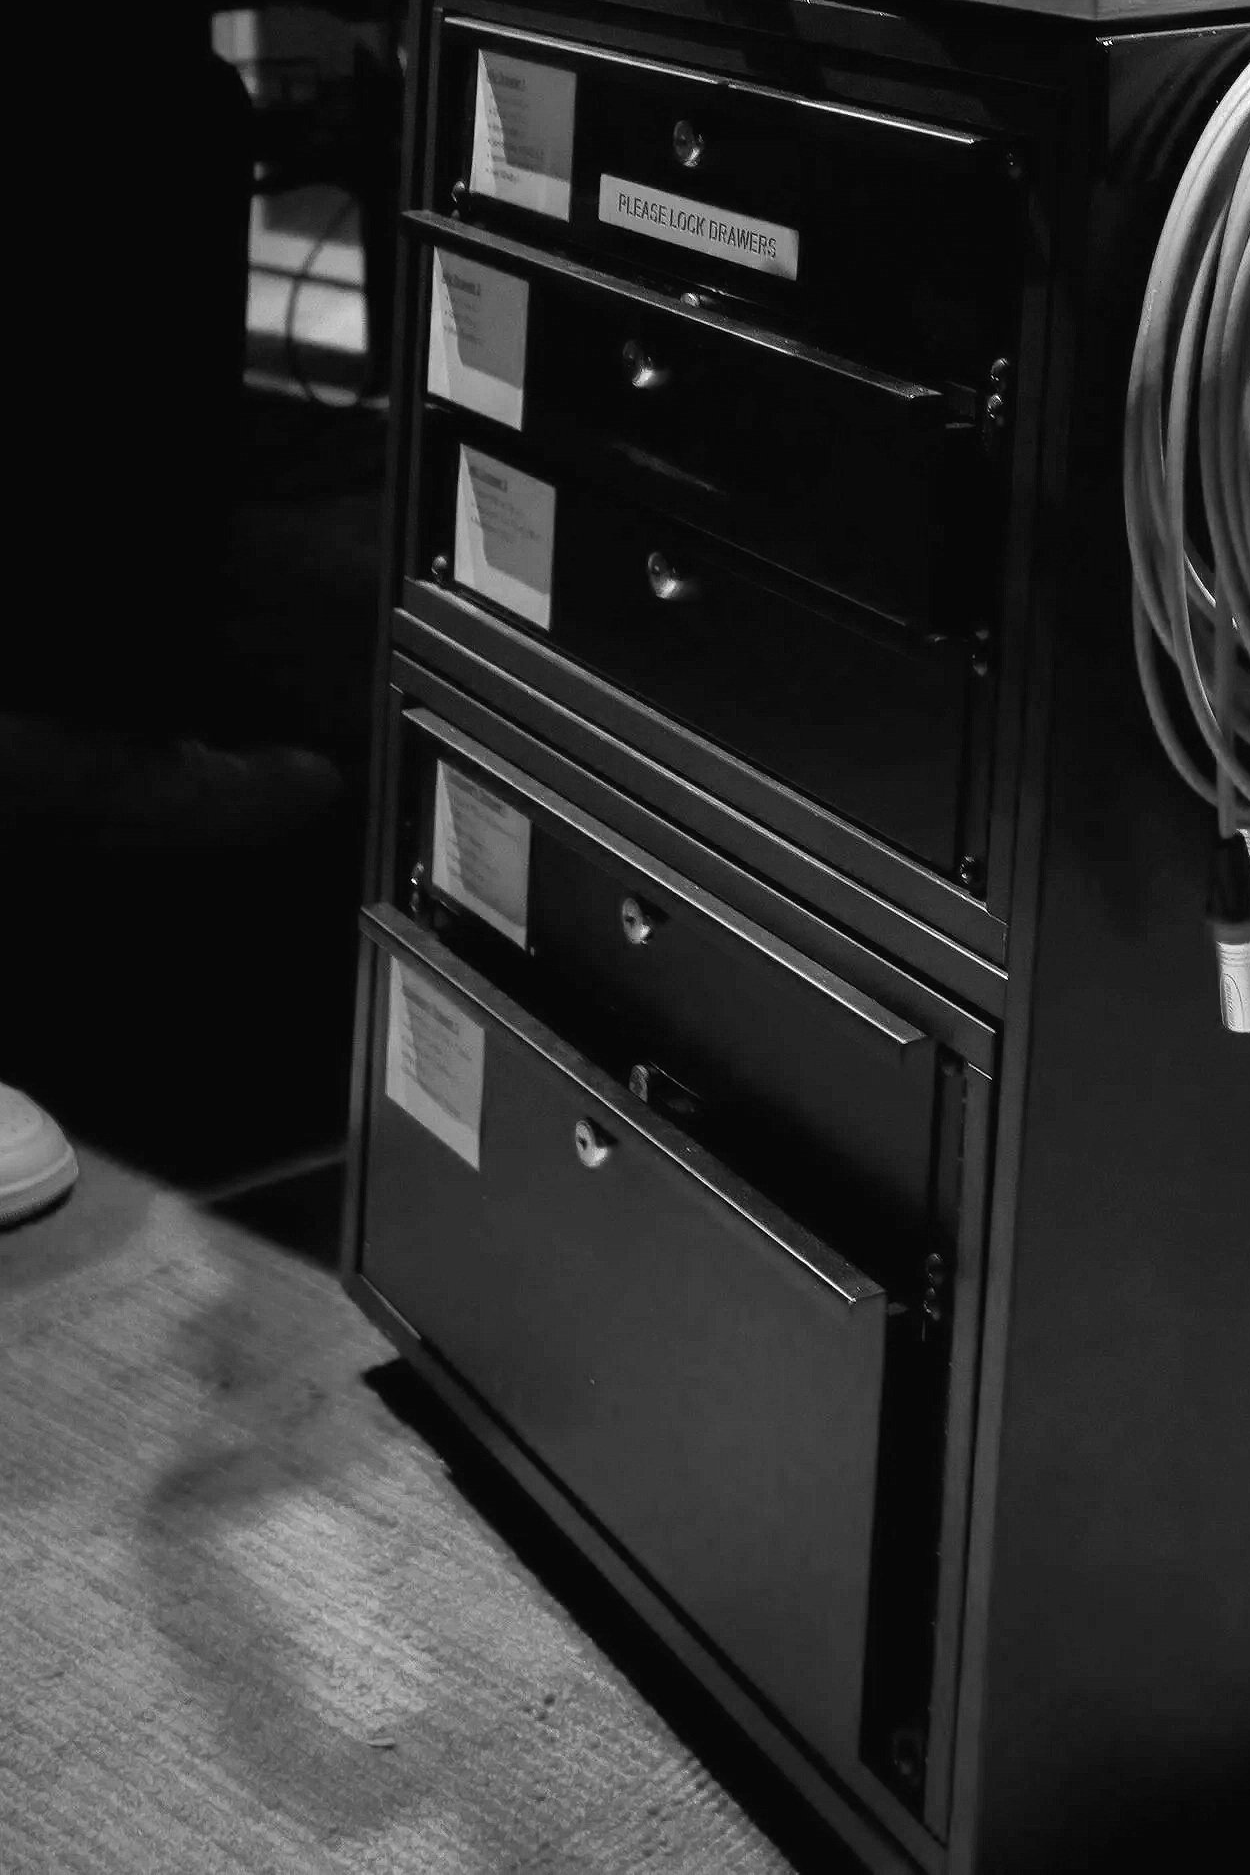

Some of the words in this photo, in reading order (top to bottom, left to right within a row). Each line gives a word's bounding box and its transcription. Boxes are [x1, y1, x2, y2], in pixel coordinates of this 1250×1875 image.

[618, 192, 667, 225] PLEASE
[669, 208, 706, 237] LOCK
[709, 220, 777, 258] DRAWERS
